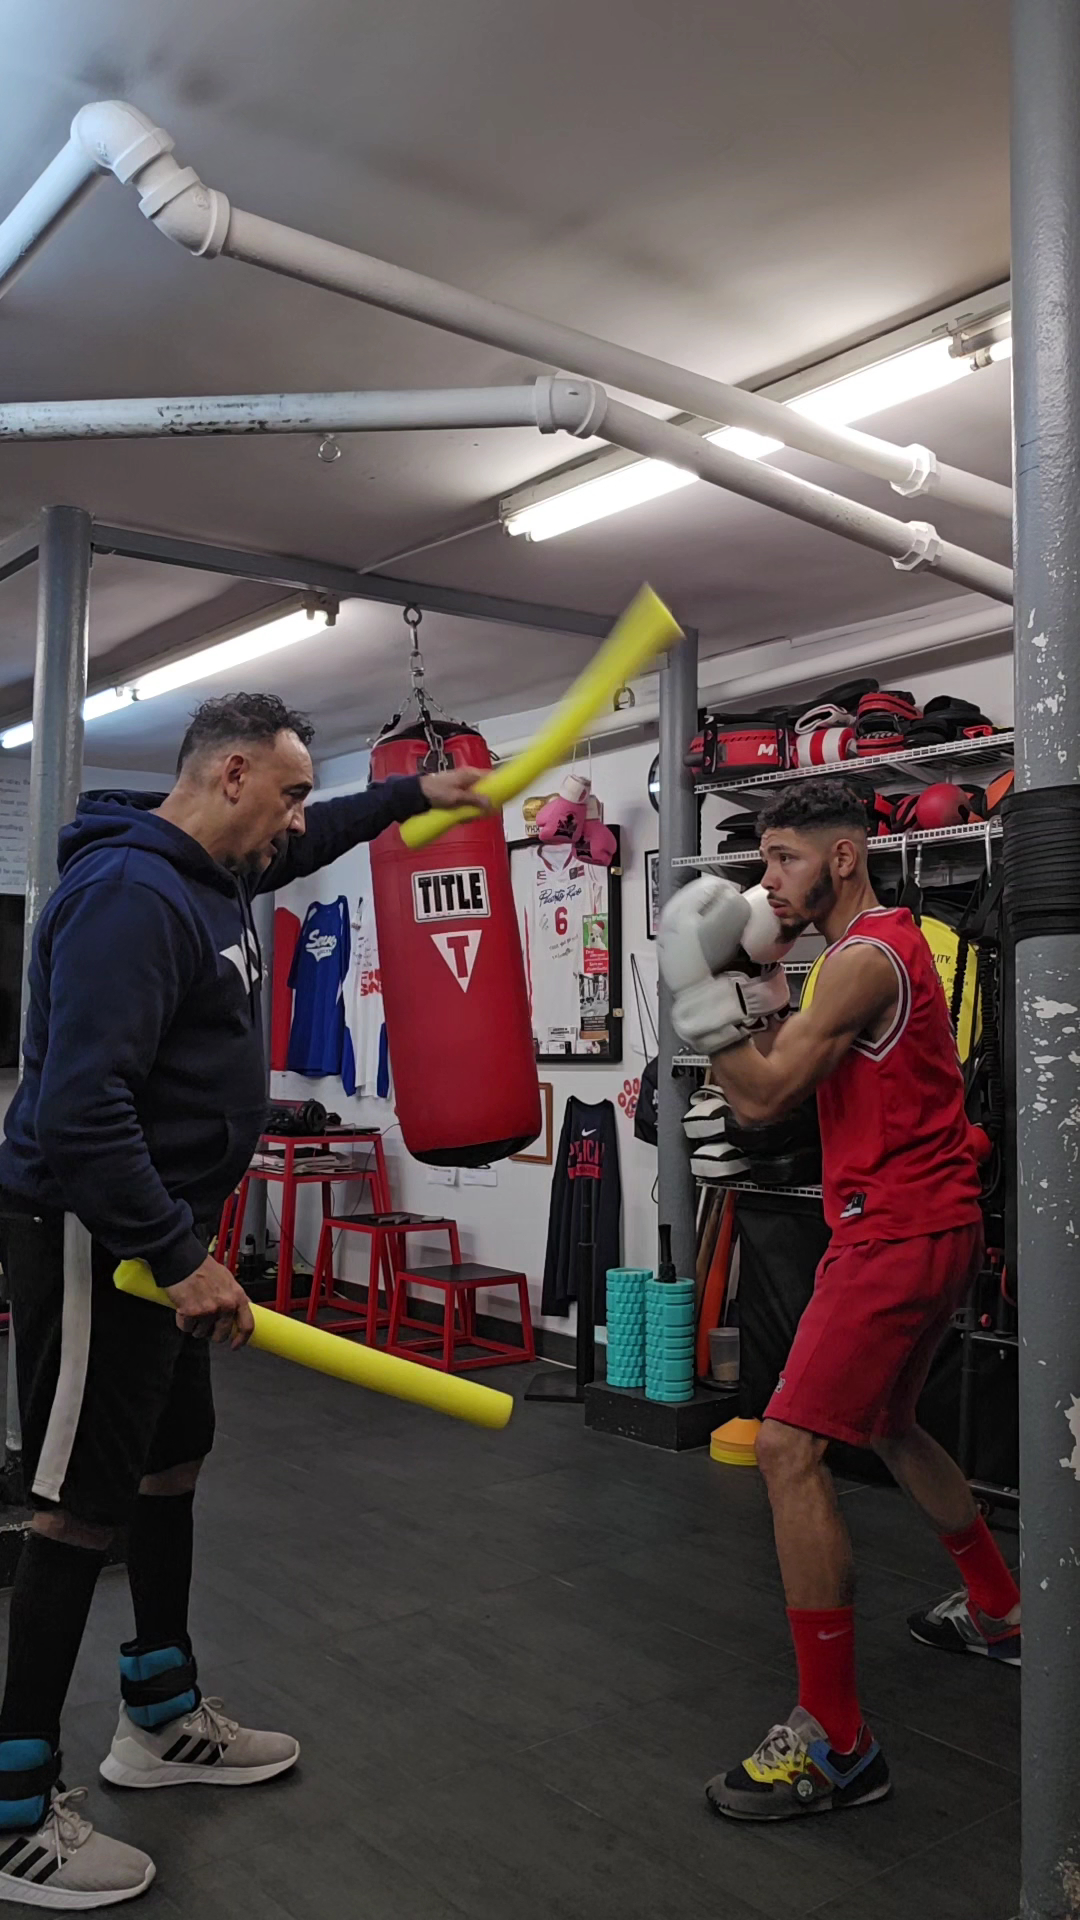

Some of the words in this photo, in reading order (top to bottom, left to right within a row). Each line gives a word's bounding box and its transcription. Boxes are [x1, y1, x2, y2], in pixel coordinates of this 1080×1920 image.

[418, 872, 484, 913] TITLE
[555, 906, 568, 935] 6
[446, 935, 470, 978] T
